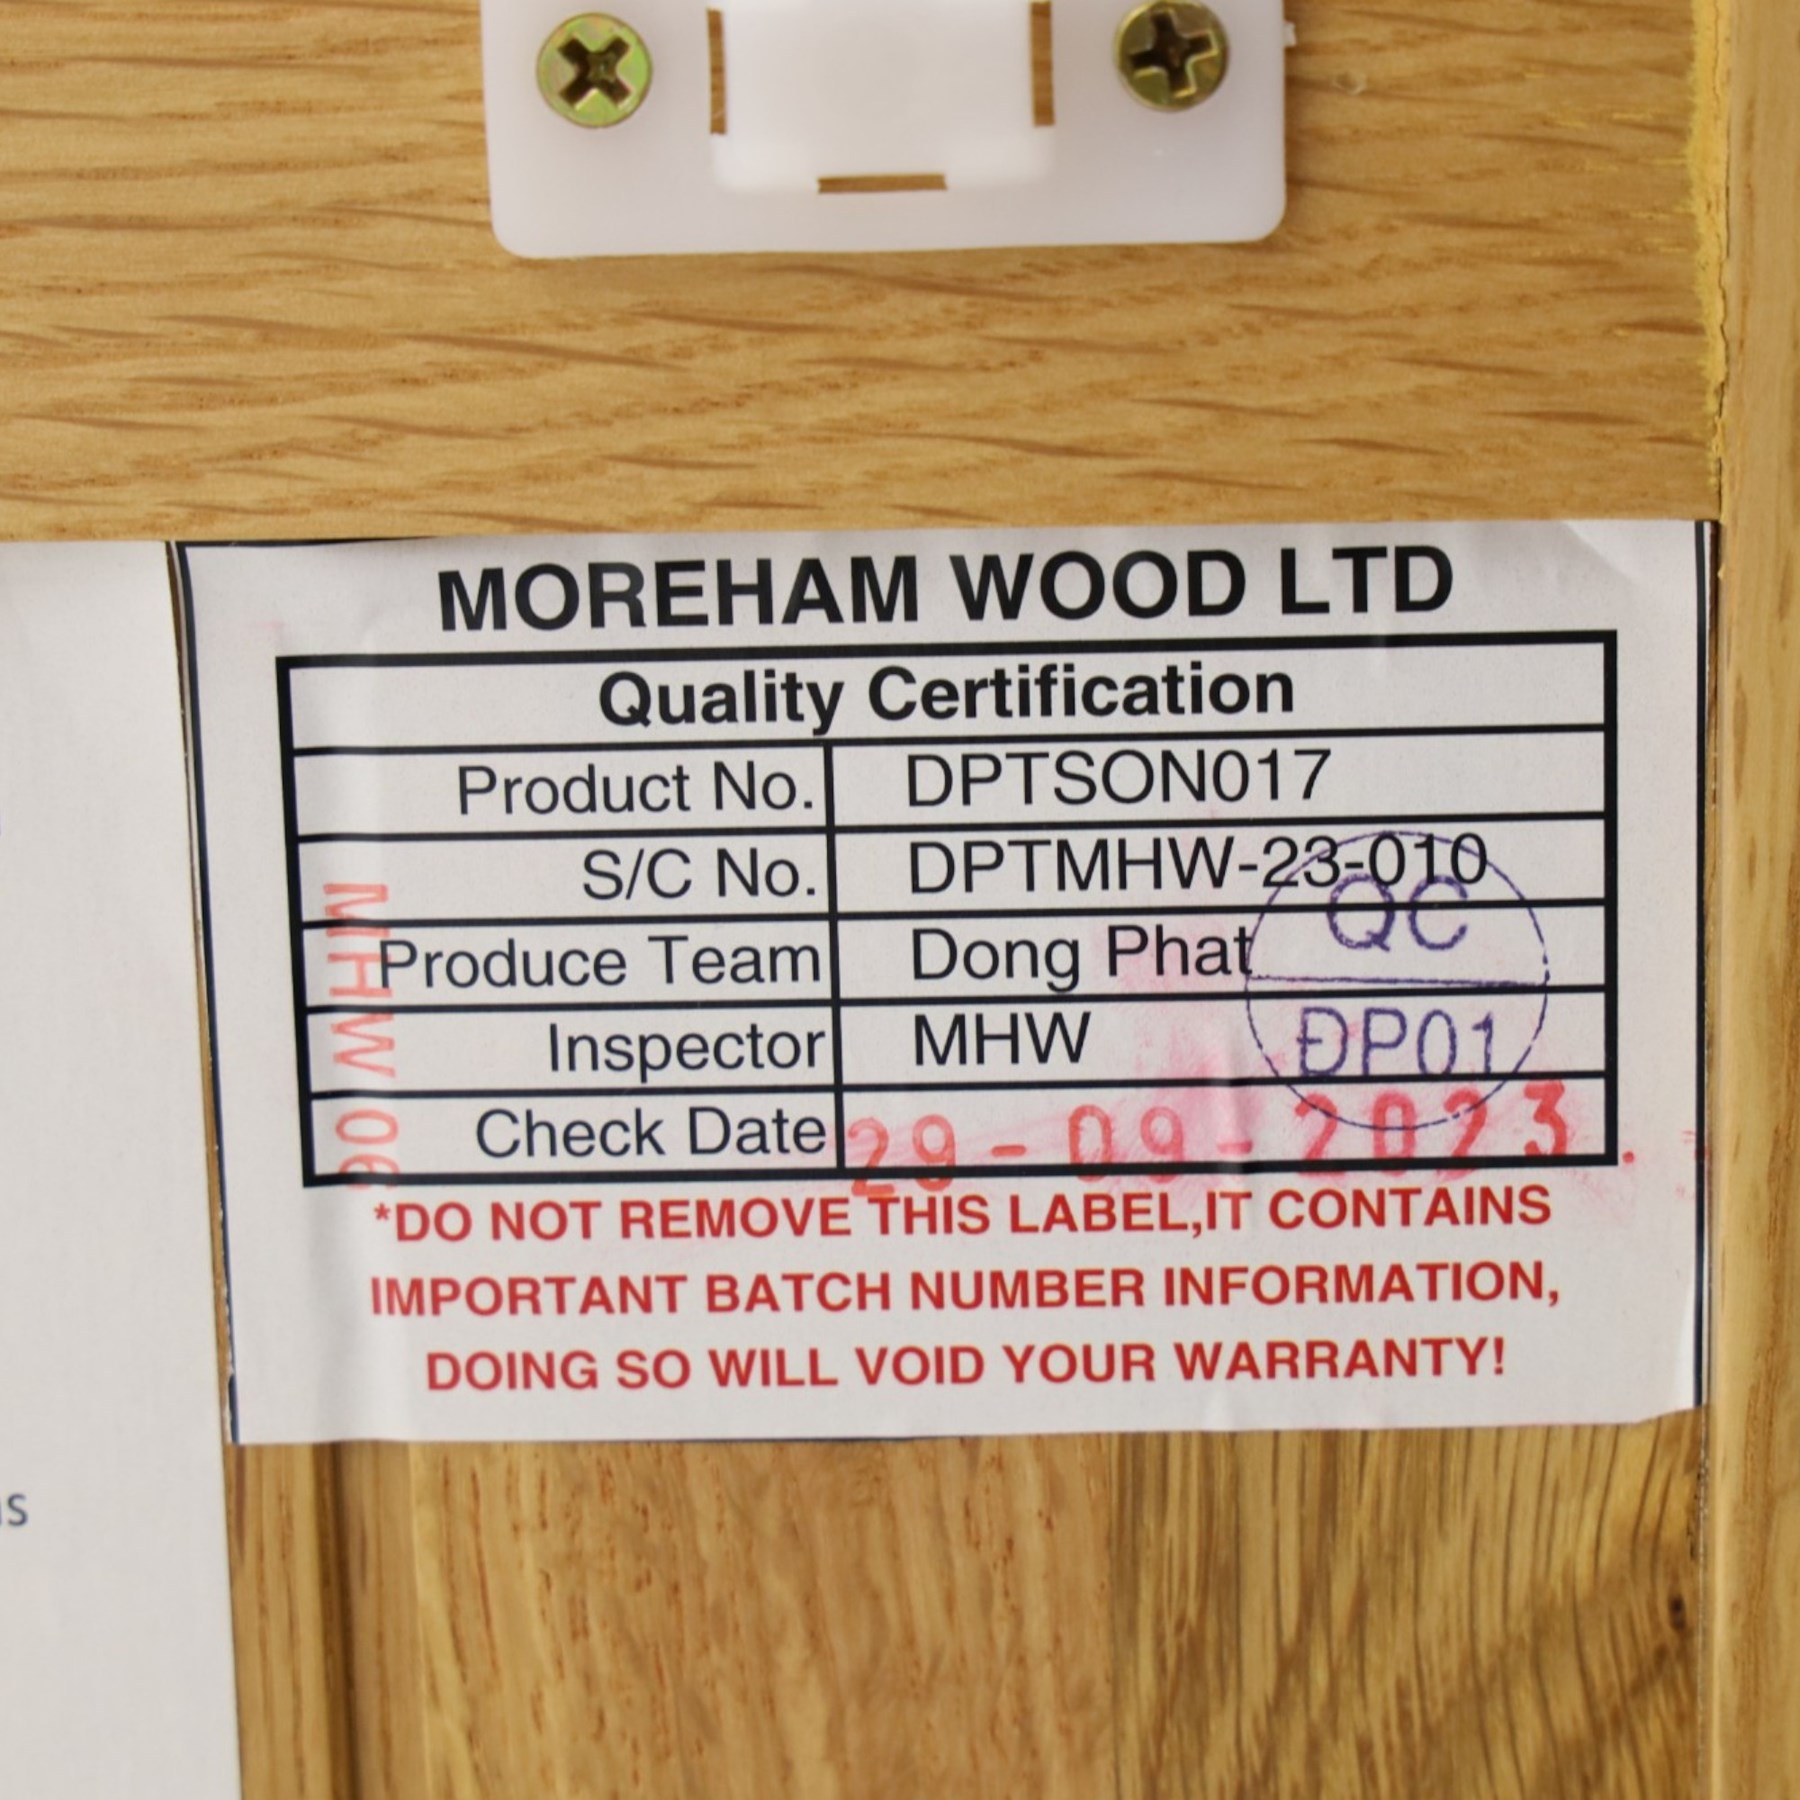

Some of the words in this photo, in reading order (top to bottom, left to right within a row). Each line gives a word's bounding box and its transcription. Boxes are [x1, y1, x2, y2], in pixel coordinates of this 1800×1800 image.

[437, 555, 919, 632] MOREHAM
[949, 549, 1246, 621] WOOD
[1280, 544, 1453, 614] LTD
[599, 670, 844, 736] Quality
[868, 661, 1295, 721] Certification
[457, 763, 690, 815] Product
[713, 760, 814, 811] No.
[906, 748, 1331, 807] DPTSON017
[582, 848, 692, 900] S/C
[717, 847, 817, 898] No.
[910, 832, 1488, 893] DPTMHW-23-010
[1326, 873, 1468, 952] QC
[323, 883, 396, 1078] MHW
[378, 939, 627, 989] Produce
[648, 935, 821, 985] Team
[912, 928, 1081, 992] Dong
[1108, 924, 1253, 978] Phat
[549, 1023, 826, 1083] Inspector
[914, 1012, 1092, 1065] MHW
[476, 1108, 666, 1158] Check
[688, 1106, 827, 1155] Date
[490, 1200, 602, 1240] NOT
[619, 1197, 852, 1239] REMOVE
[867, 1195, 991, 1235] THIS
[1268, 1184, 1552, 1230] CONTAINS
[371, 1275, 688, 1316] IMPORTANT
[706, 1272, 891, 1313] BATCH
[910, 1268, 1145, 1311] NUMBER
[1164, 1261, 1559, 1308] INFORMATION,
[426, 1351, 598, 1391] DOING
[616, 1349, 691, 1389] SO
[708, 1347, 838, 1387] WILL
[855, 1345, 985, 1386] VOID
[1002, 1343, 1156, 1384] YOUR
[1173, 1336, 1505, 1381] WARRANTY!
